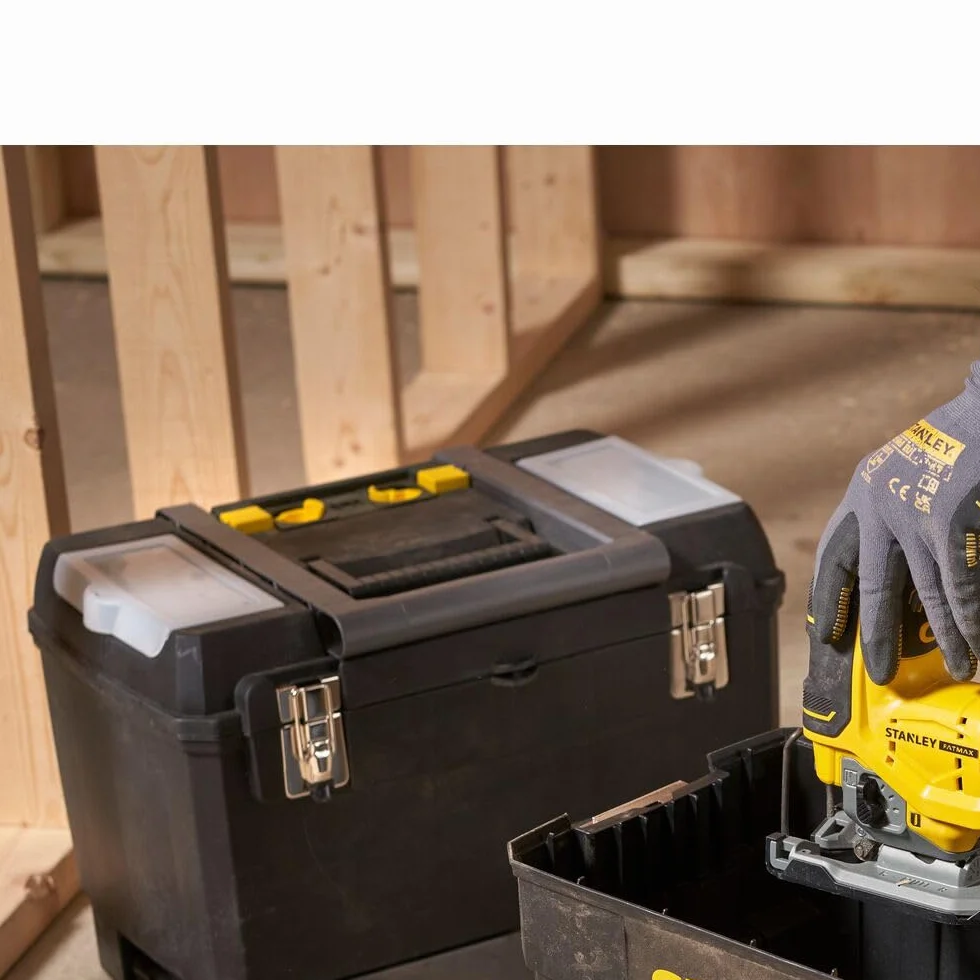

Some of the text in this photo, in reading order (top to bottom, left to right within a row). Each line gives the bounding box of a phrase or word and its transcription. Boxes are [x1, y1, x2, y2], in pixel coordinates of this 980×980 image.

[911, 423, 955, 455] ANLEY
[888, 477, 911, 502] CE
[885, 727, 976, 757] STANLEY FATMAX
